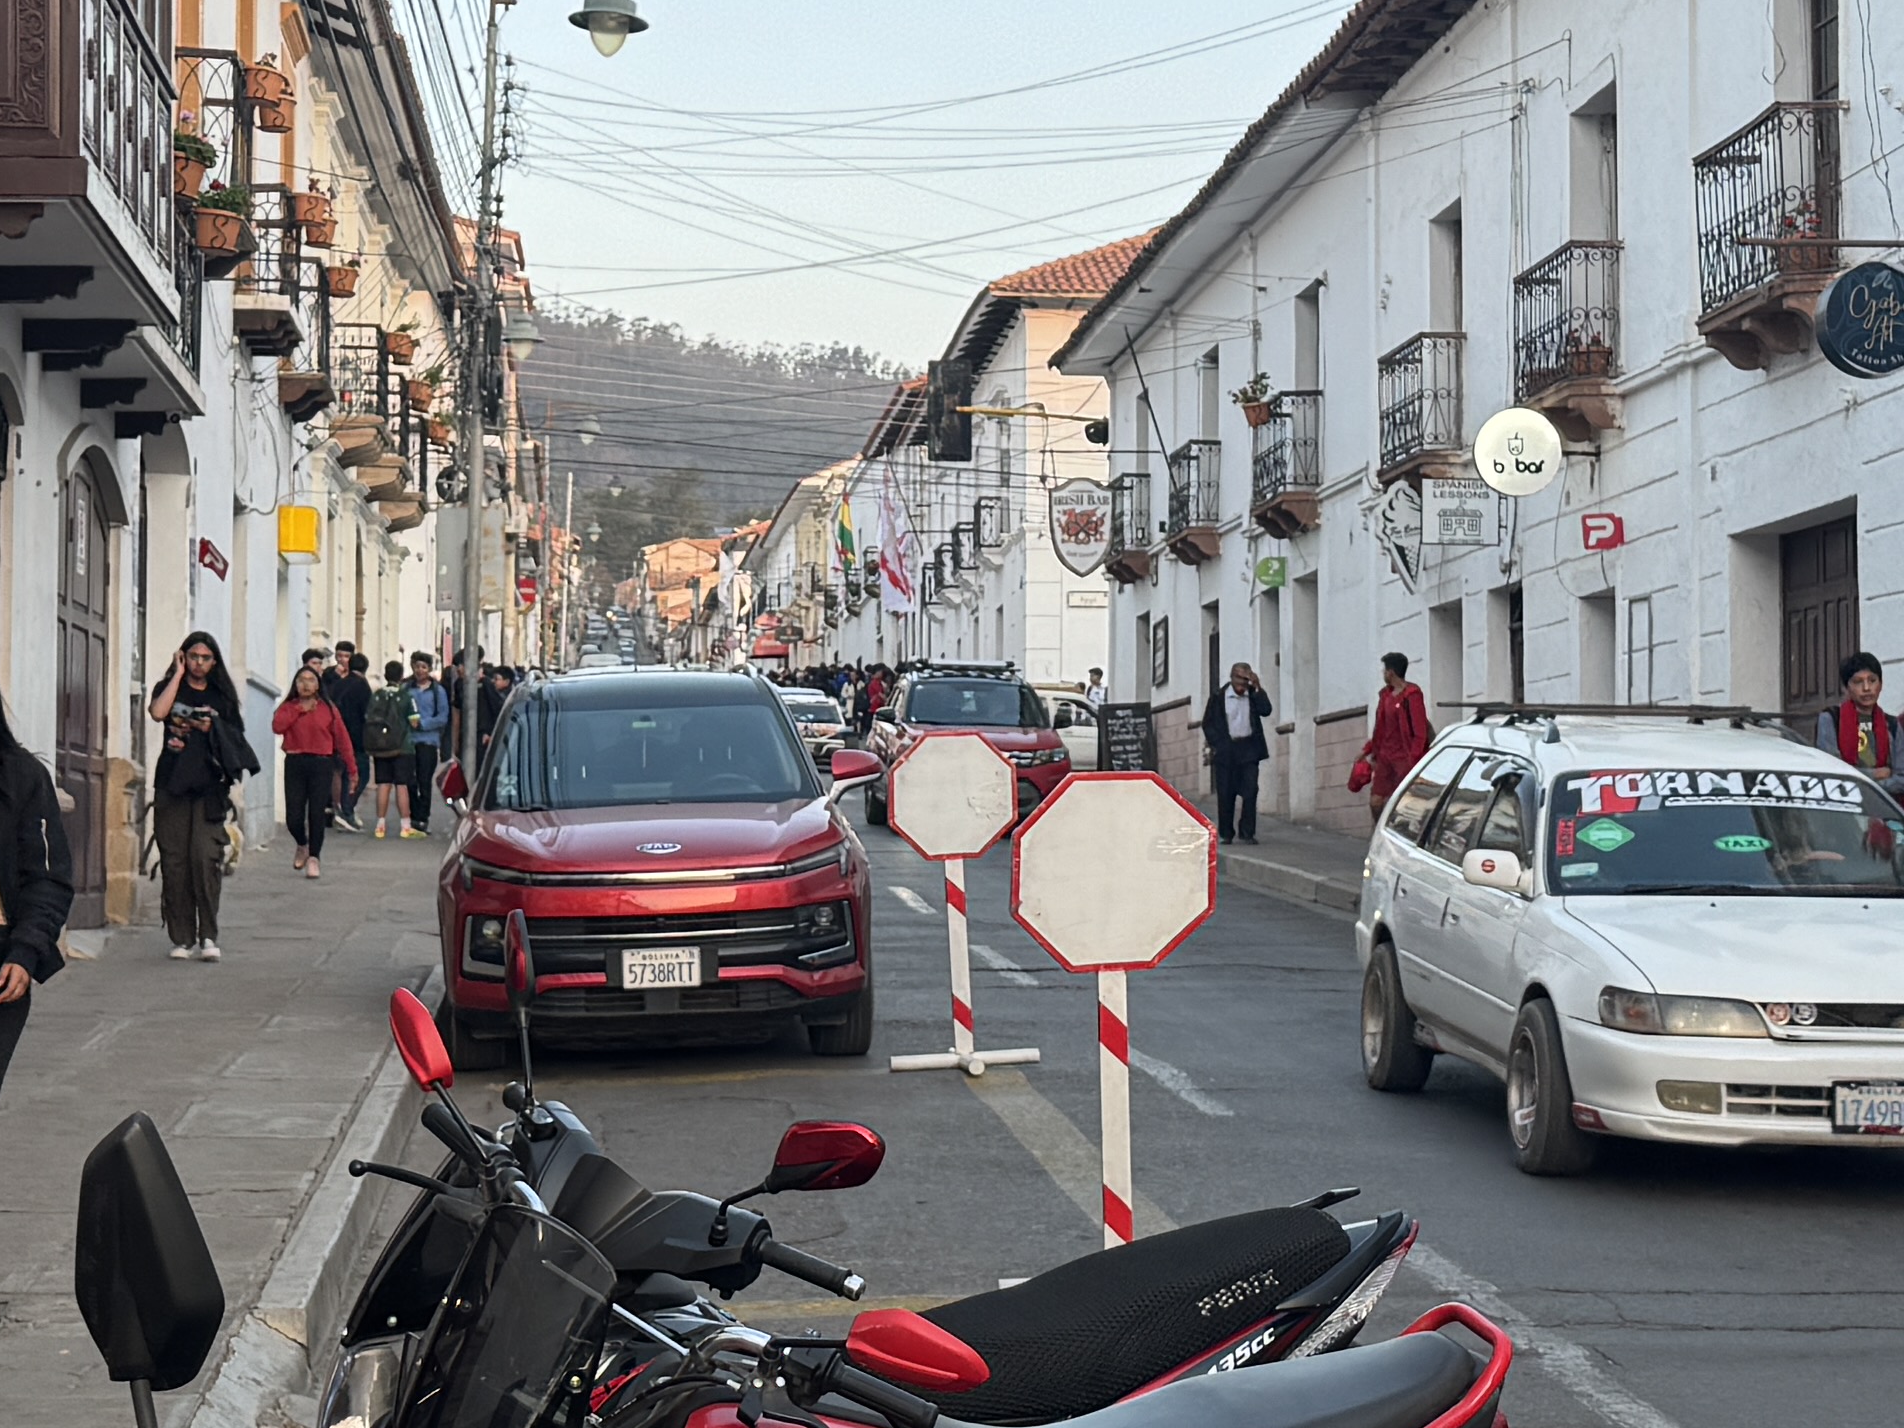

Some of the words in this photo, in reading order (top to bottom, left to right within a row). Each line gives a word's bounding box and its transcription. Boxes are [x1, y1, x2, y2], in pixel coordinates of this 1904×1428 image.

[1054, 494, 1084, 506] IRISH
[1087, 493, 1110, 506] BAR
[1432, 490, 1490, 499] LESSONS
[1567, 771, 1863, 813] TORNADO
[1723, 839, 1765, 849] TAXI
[641, 952, 681, 961] BOLIVIA
